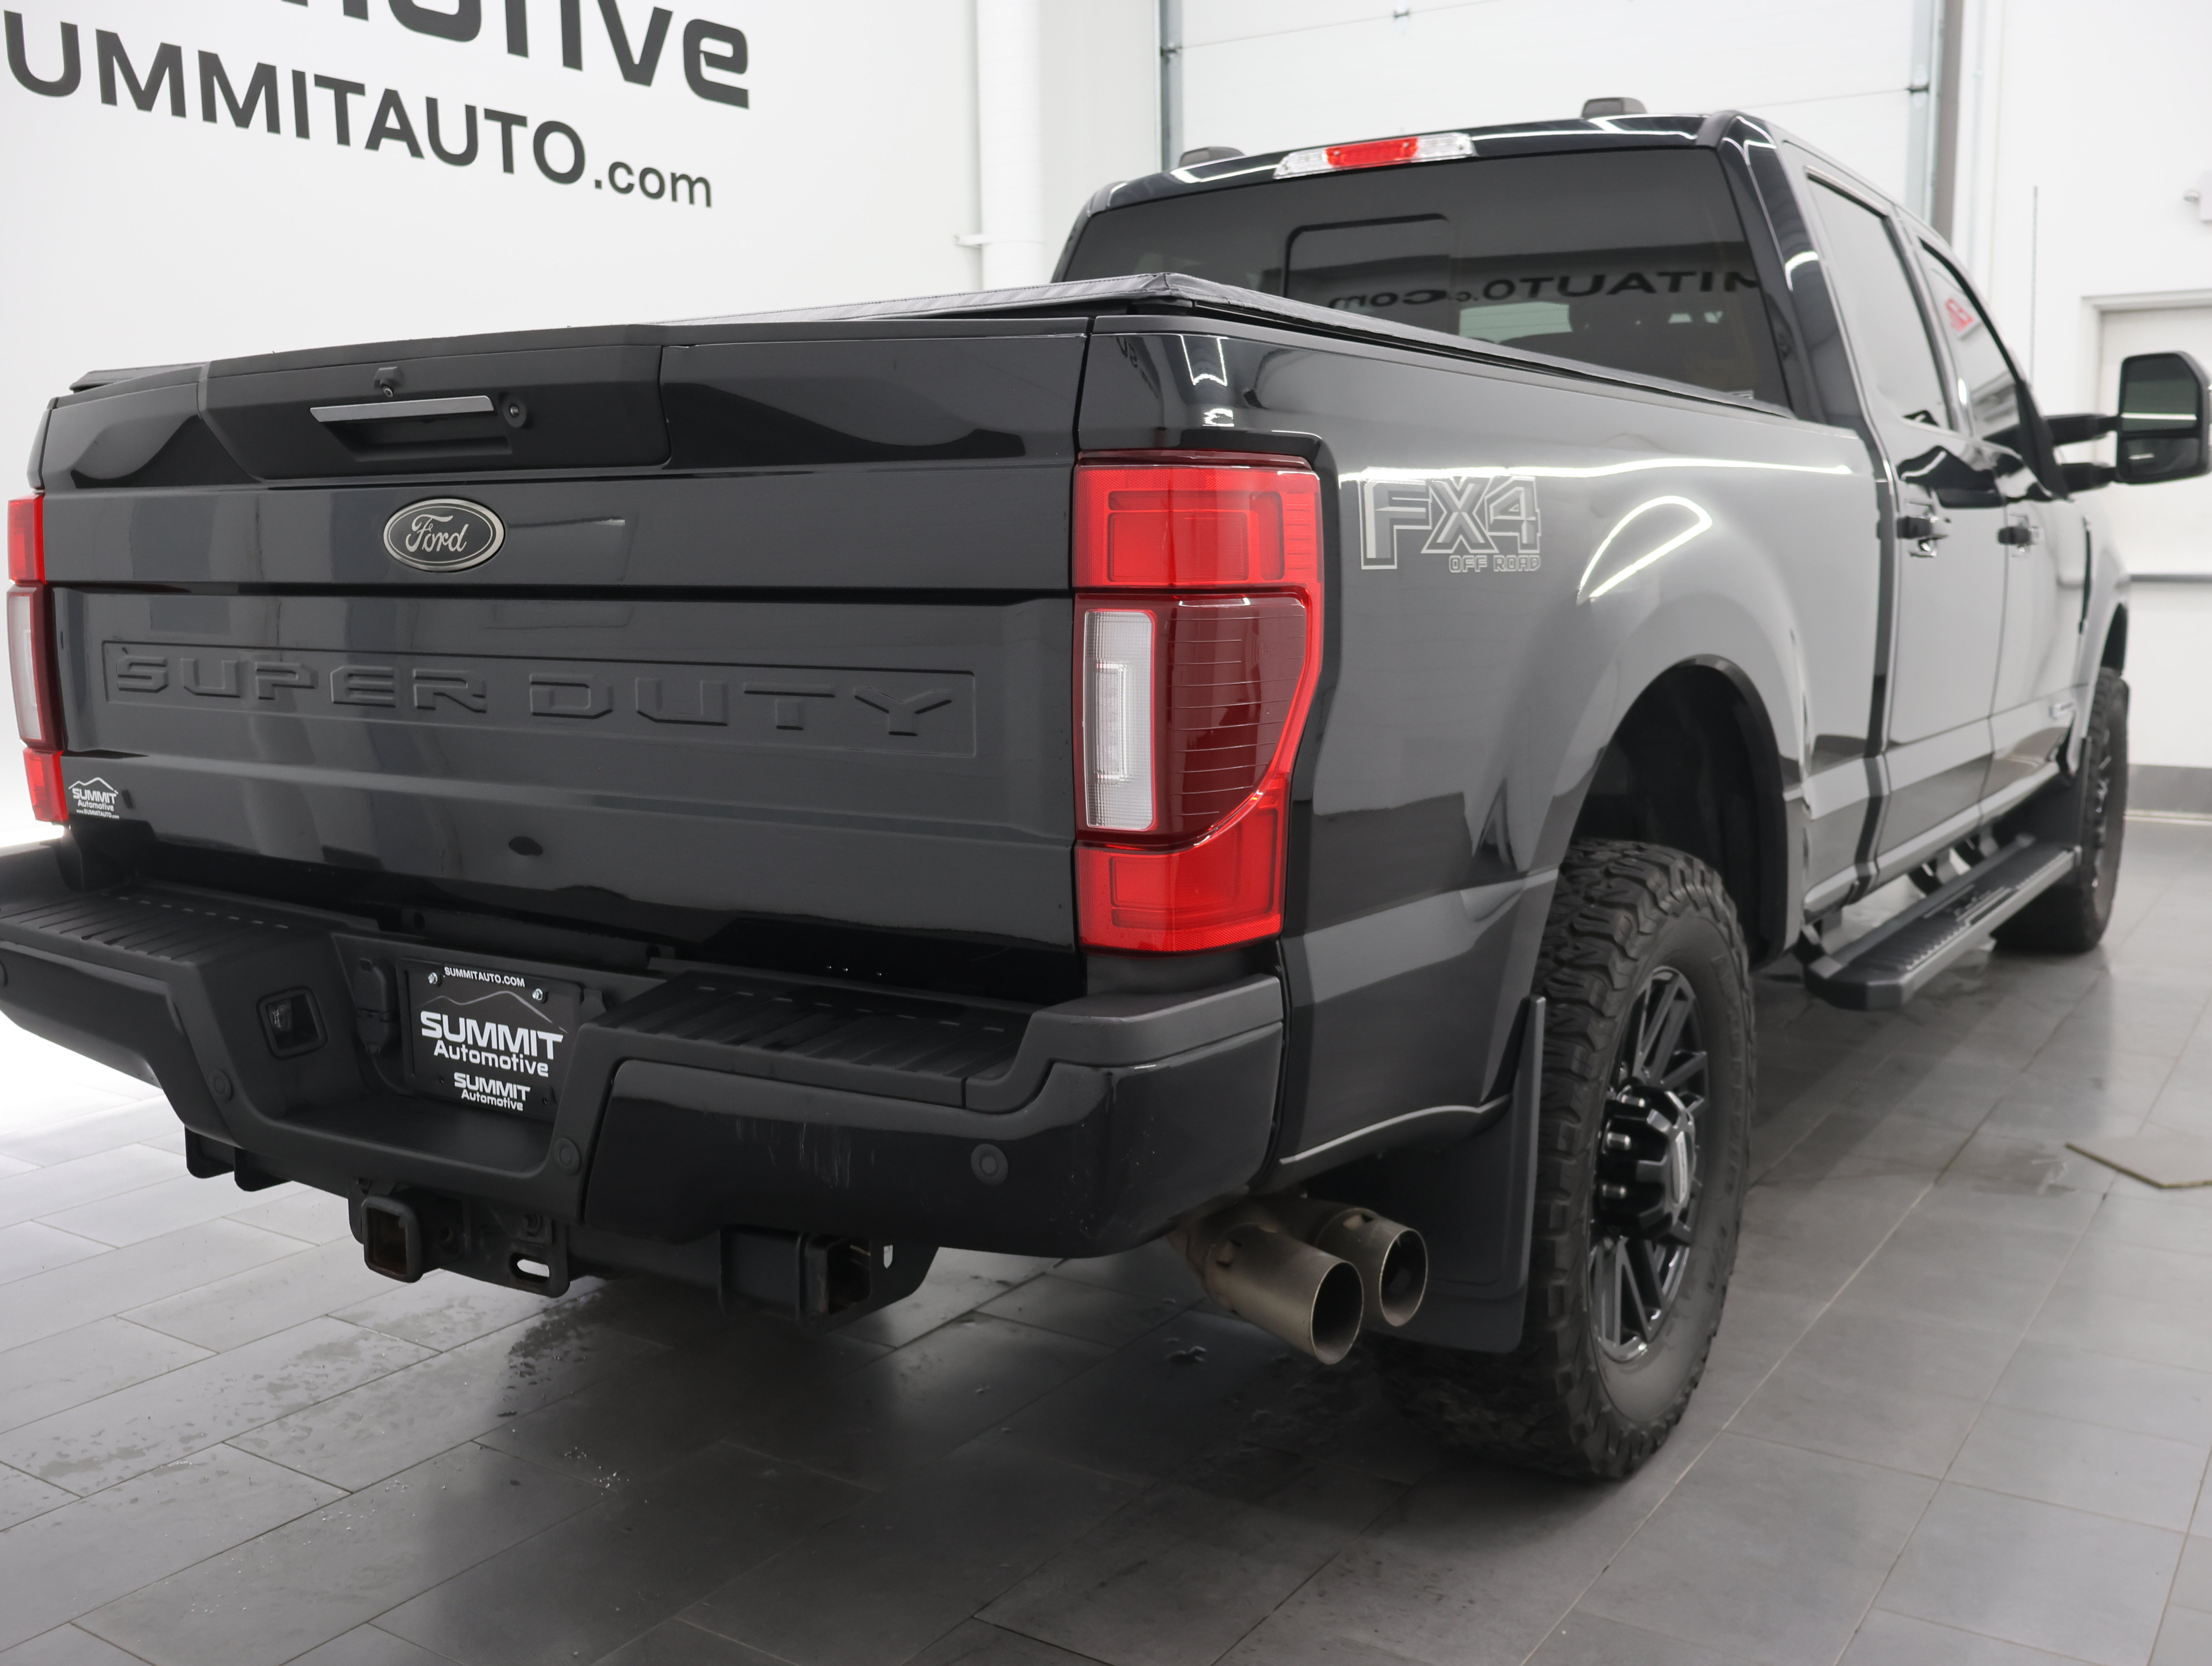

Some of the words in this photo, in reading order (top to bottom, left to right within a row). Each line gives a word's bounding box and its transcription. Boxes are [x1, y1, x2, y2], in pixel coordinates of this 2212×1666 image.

[405, 514, 469, 552] Ford
[1358, 476, 1541, 570] FX4
[1448, 555, 1488, 573] OFF
[1493, 555, 1541, 572] ROAD
[116, 656, 488, 713] SUPER
[529, 673, 953, 736] DUTY
[72, 787, 117, 804] SUMMIT
[78, 799, 114, 812] Automotive
[420, 1011, 564, 1060] SUMMIT
[434, 1039, 548, 1078] Automotive
[454, 1072, 531, 1101] SUMMIT
[461, 1089, 523, 1111] Automotive
